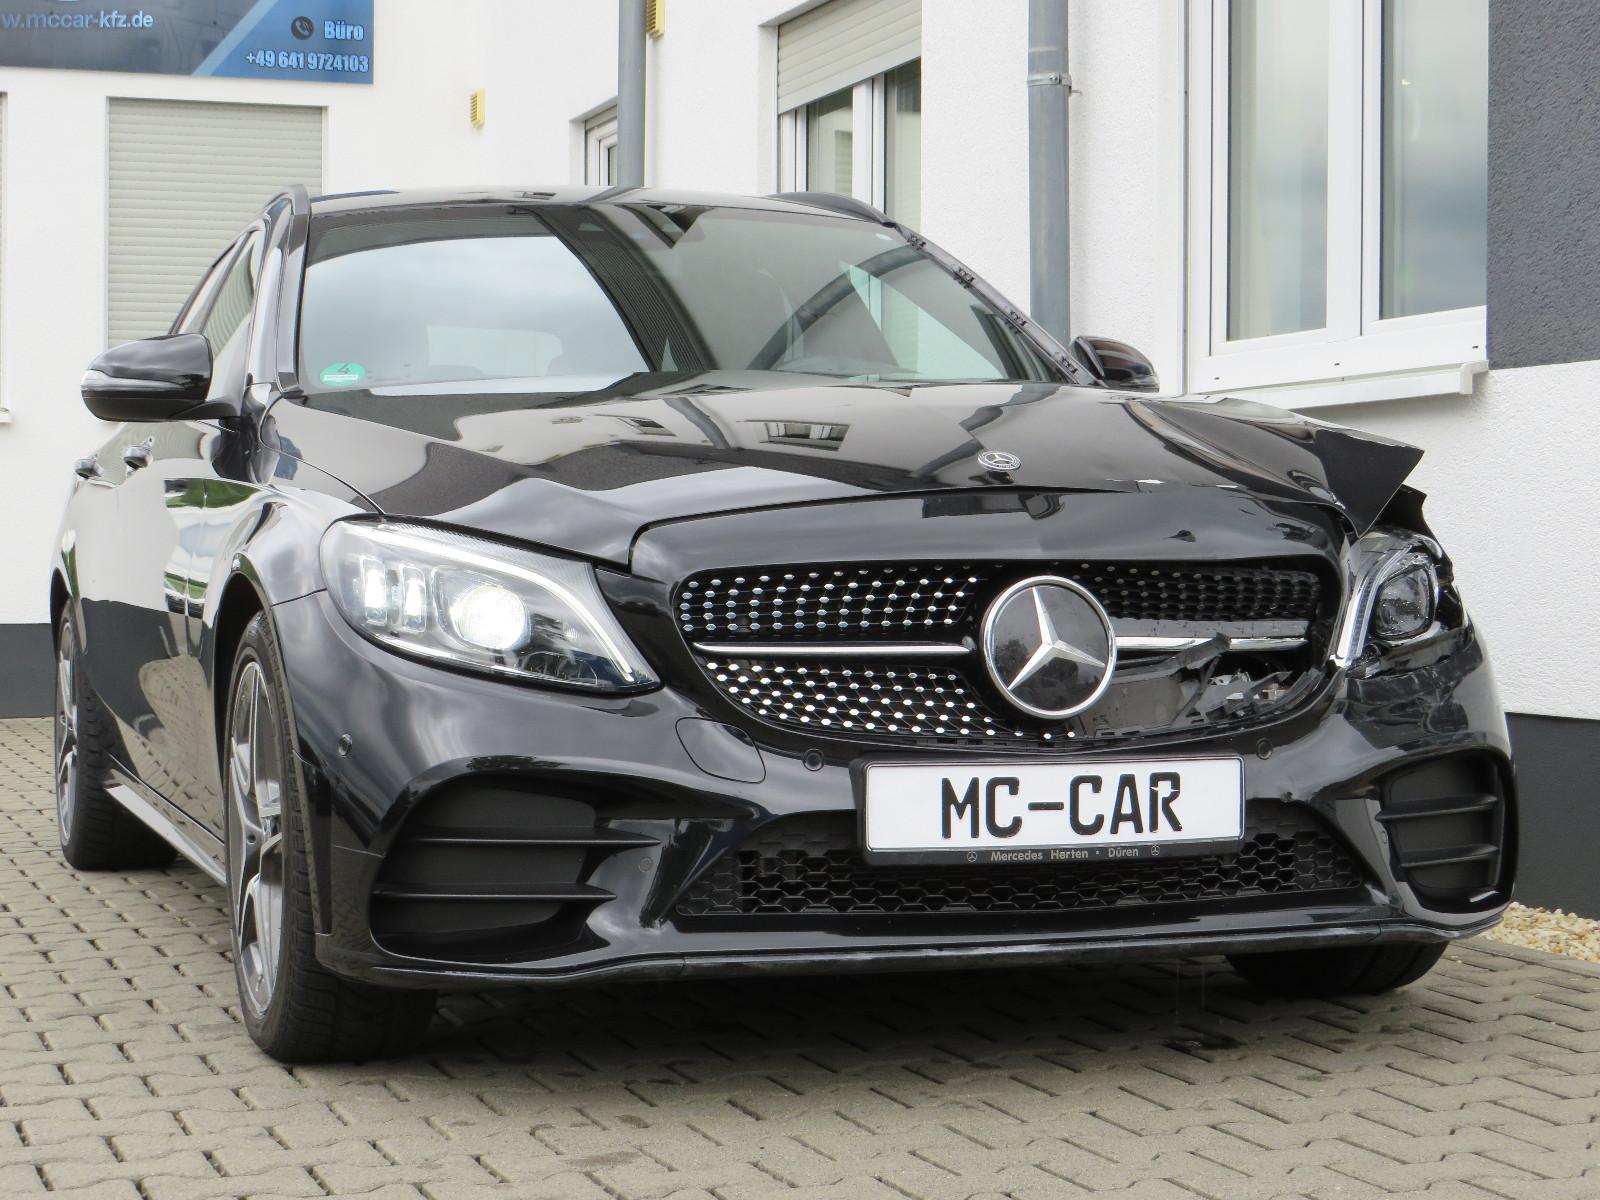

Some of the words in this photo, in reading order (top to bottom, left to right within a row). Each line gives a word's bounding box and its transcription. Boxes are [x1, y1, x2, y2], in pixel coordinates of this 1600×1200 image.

[323, 20, 365, 41] Büro
[246, 50, 276, 68] +49
[278, 51, 305, 69] 641
[307, 53, 370, 73] 9724103
[941, 771, 1184, 839] MC-CAR
[990, 850, 1043, 862] Mercedes
[1108, 846, 1139, 858] Düren
